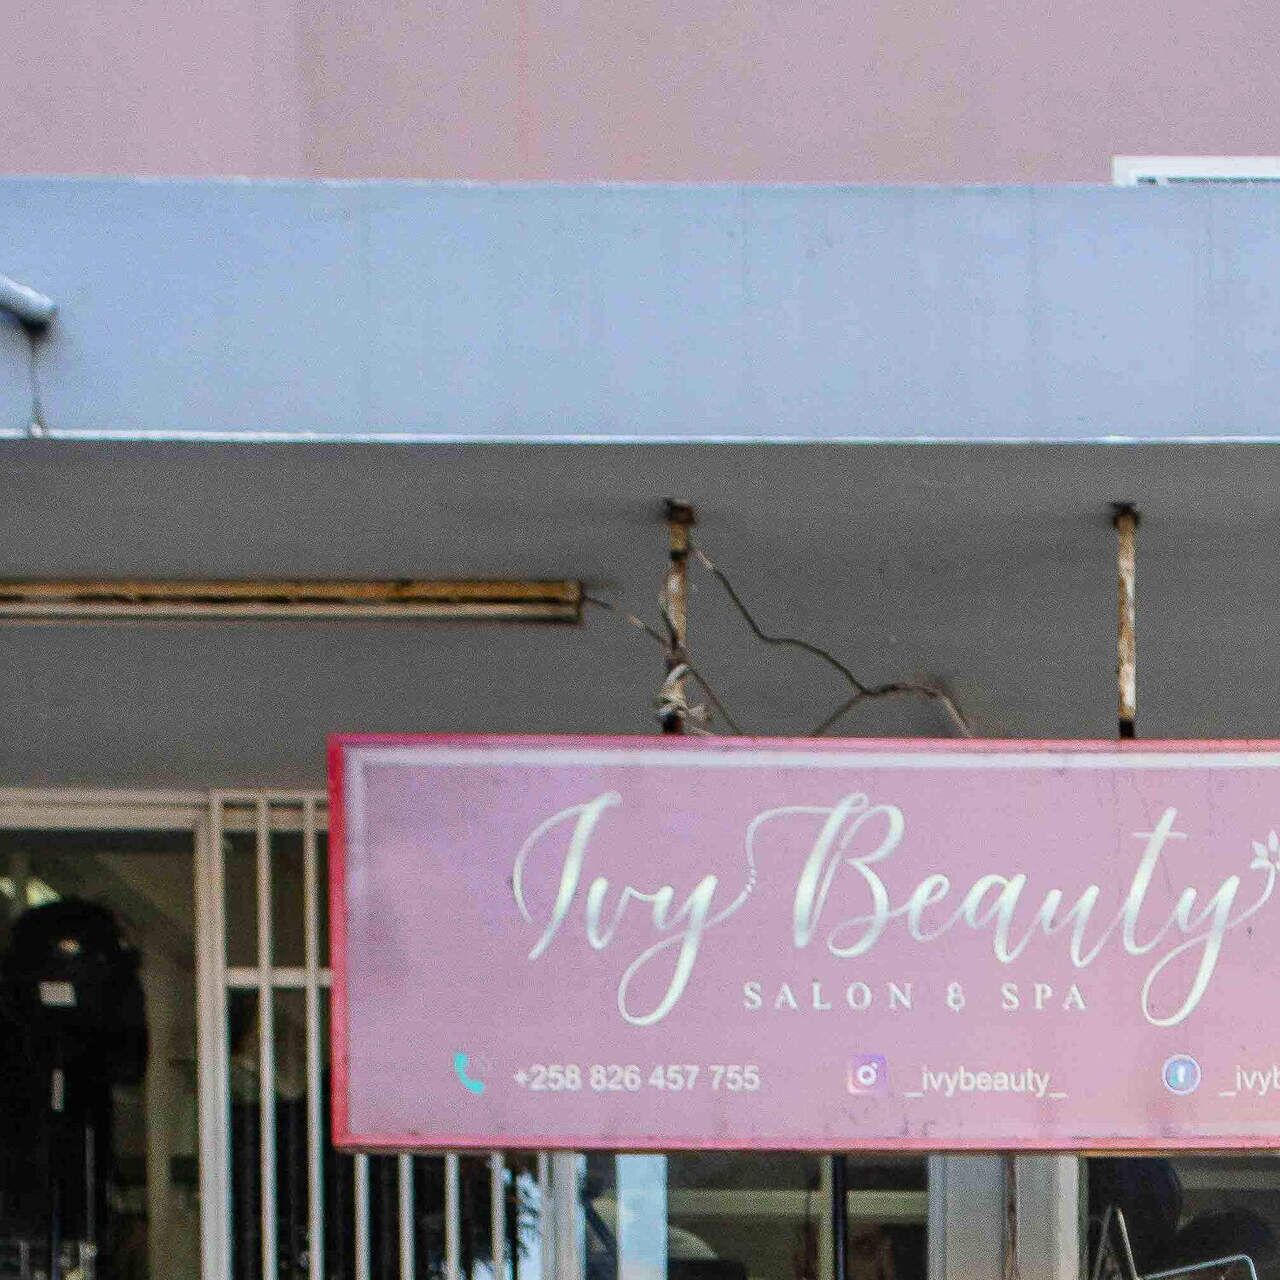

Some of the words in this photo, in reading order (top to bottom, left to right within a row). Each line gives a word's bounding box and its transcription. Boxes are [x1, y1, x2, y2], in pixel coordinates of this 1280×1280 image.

[513, 791, 753, 1026] Ivy
[746, 792, 1277, 1026] Beauty
[743, 981, 914, 1012] SALON
[948, 981, 966, 1013] &
[1000, 982, 1088, 1012] SPA
[514, 1064, 582, 1092] +258
[590, 1064, 642, 1092] 826
[649, 1064, 700, 1091] 457
[708, 1064, 760, 1092] 755
[904, 1065, 1069, 1097] _ivybeauty_
